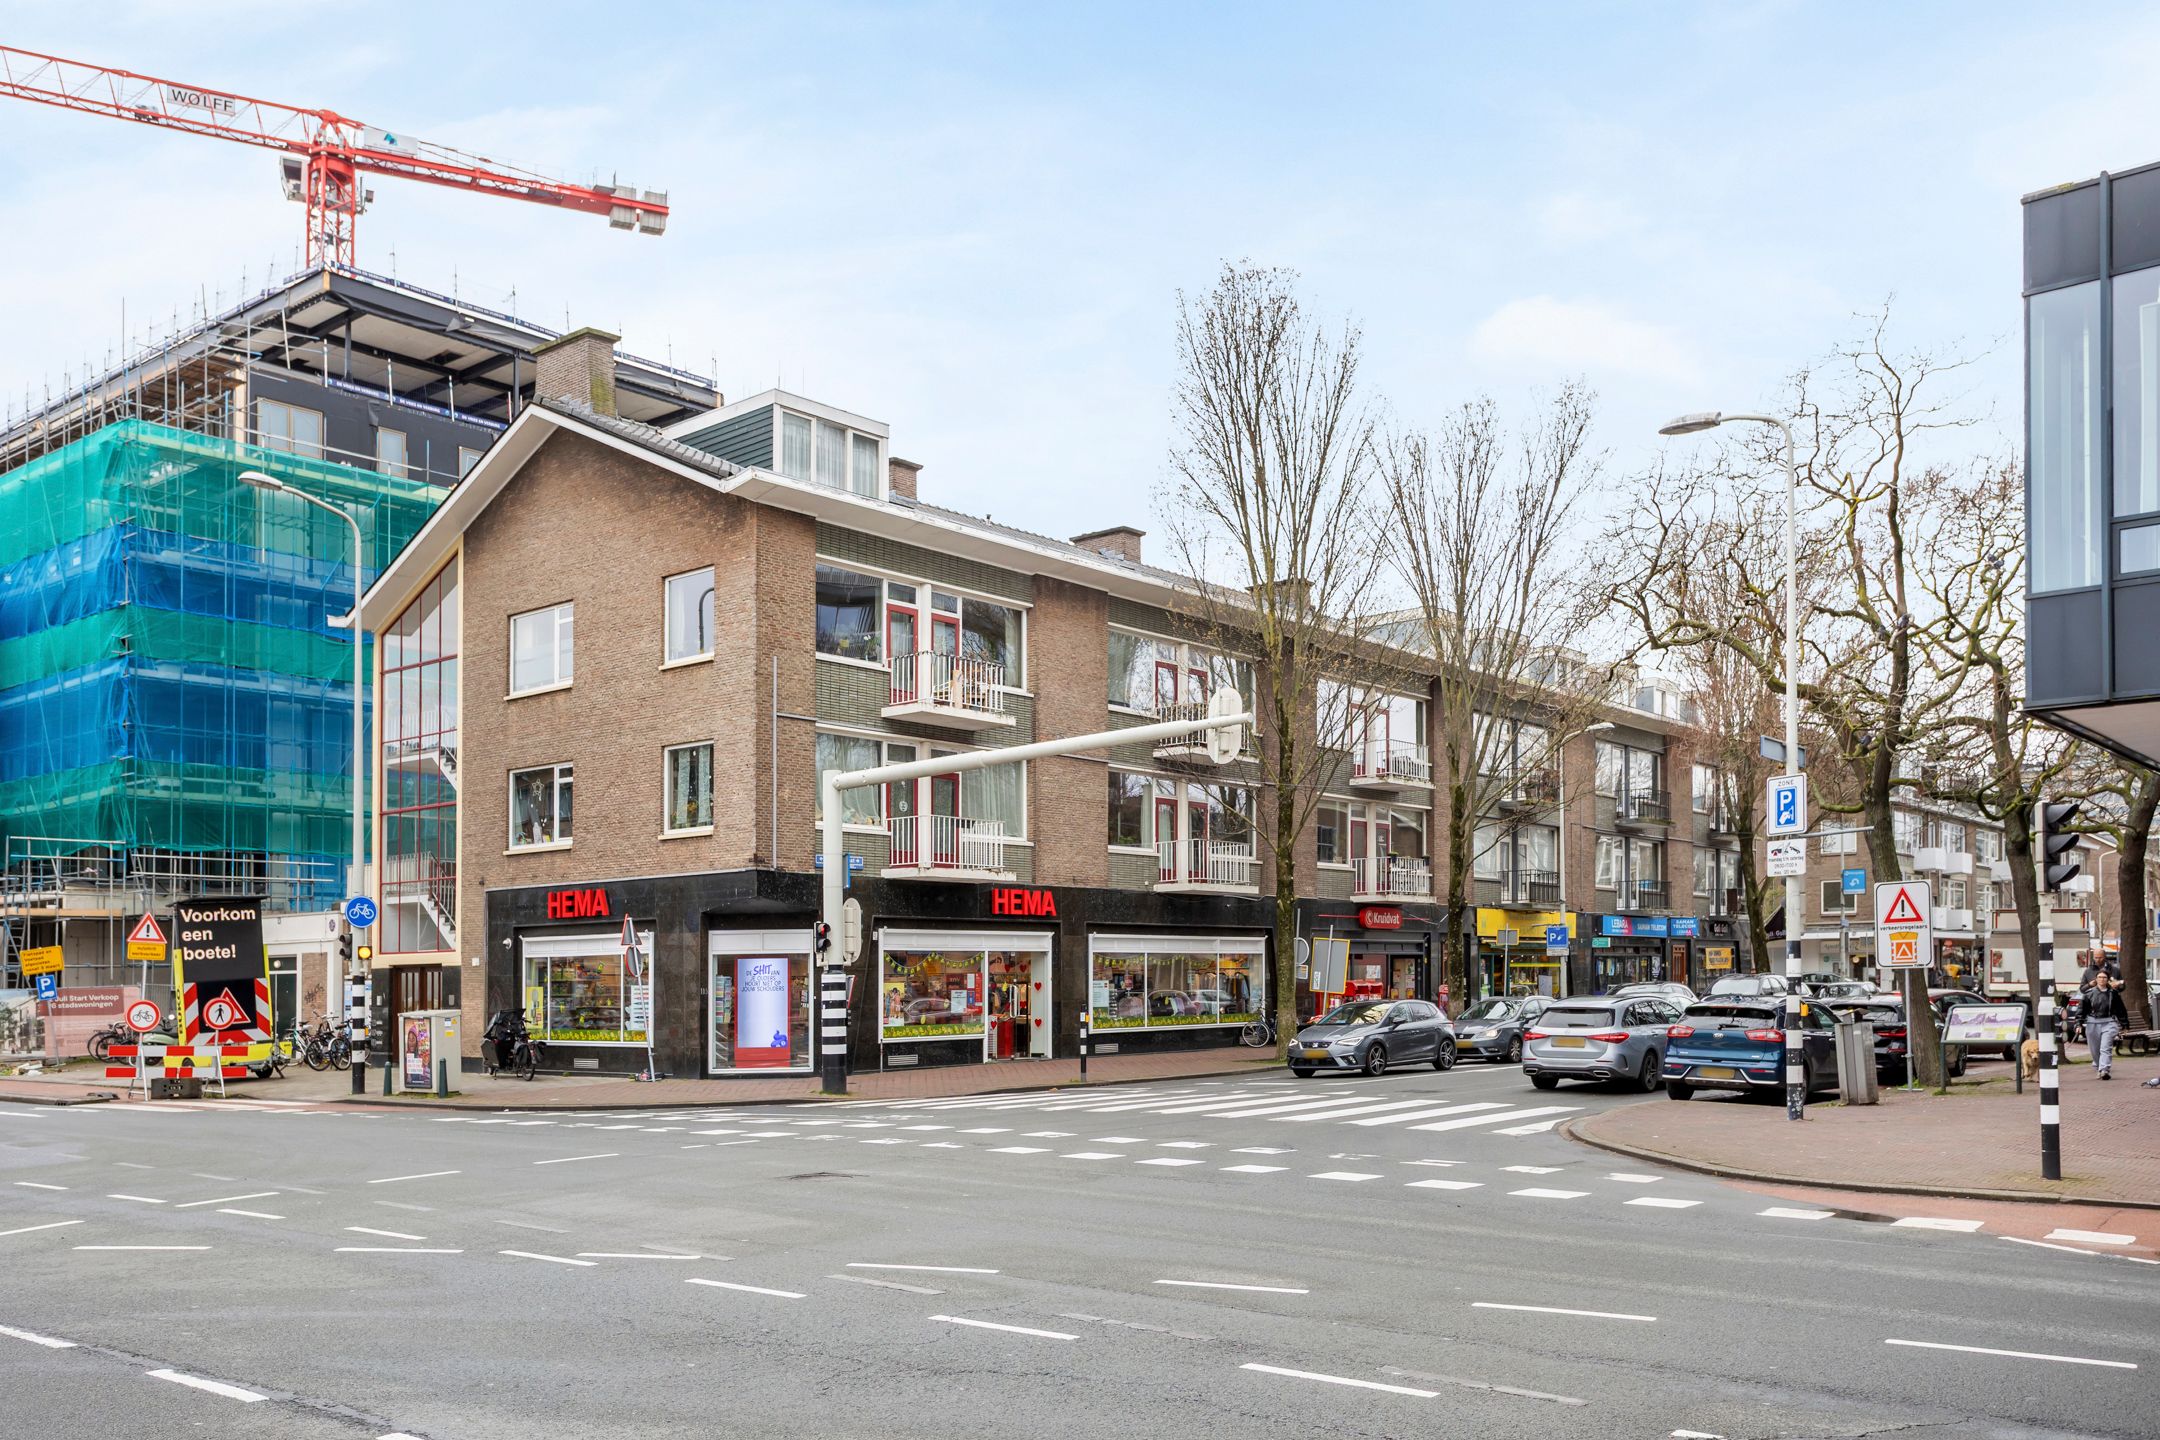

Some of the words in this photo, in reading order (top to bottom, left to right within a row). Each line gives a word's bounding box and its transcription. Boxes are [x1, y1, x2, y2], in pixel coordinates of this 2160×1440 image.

[171, 88, 234, 111] WOLFF
[1777, 779, 1794, 787] ZONE
[1780, 790, 1793, 811] P
[548, 887, 609, 919] HEMA
[992, 887, 1057, 917] HEMA
[180, 907, 257, 923] Voorkom
[1373, 911, 1400, 925] Kruidvat
[1611, 918, 1629, 929] LEBARA
[182, 929, 213, 942] een
[1549, 932, 1557, 942] P
[183, 944, 237, 961] boete!
[753, 964, 772, 976] SHIT
[40, 977, 51, 991] P
[69, 994, 88, 1002] Start
[88, 993, 119, 1002] Verkoop
[57, 1001, 113, 1009] stadswoningen
